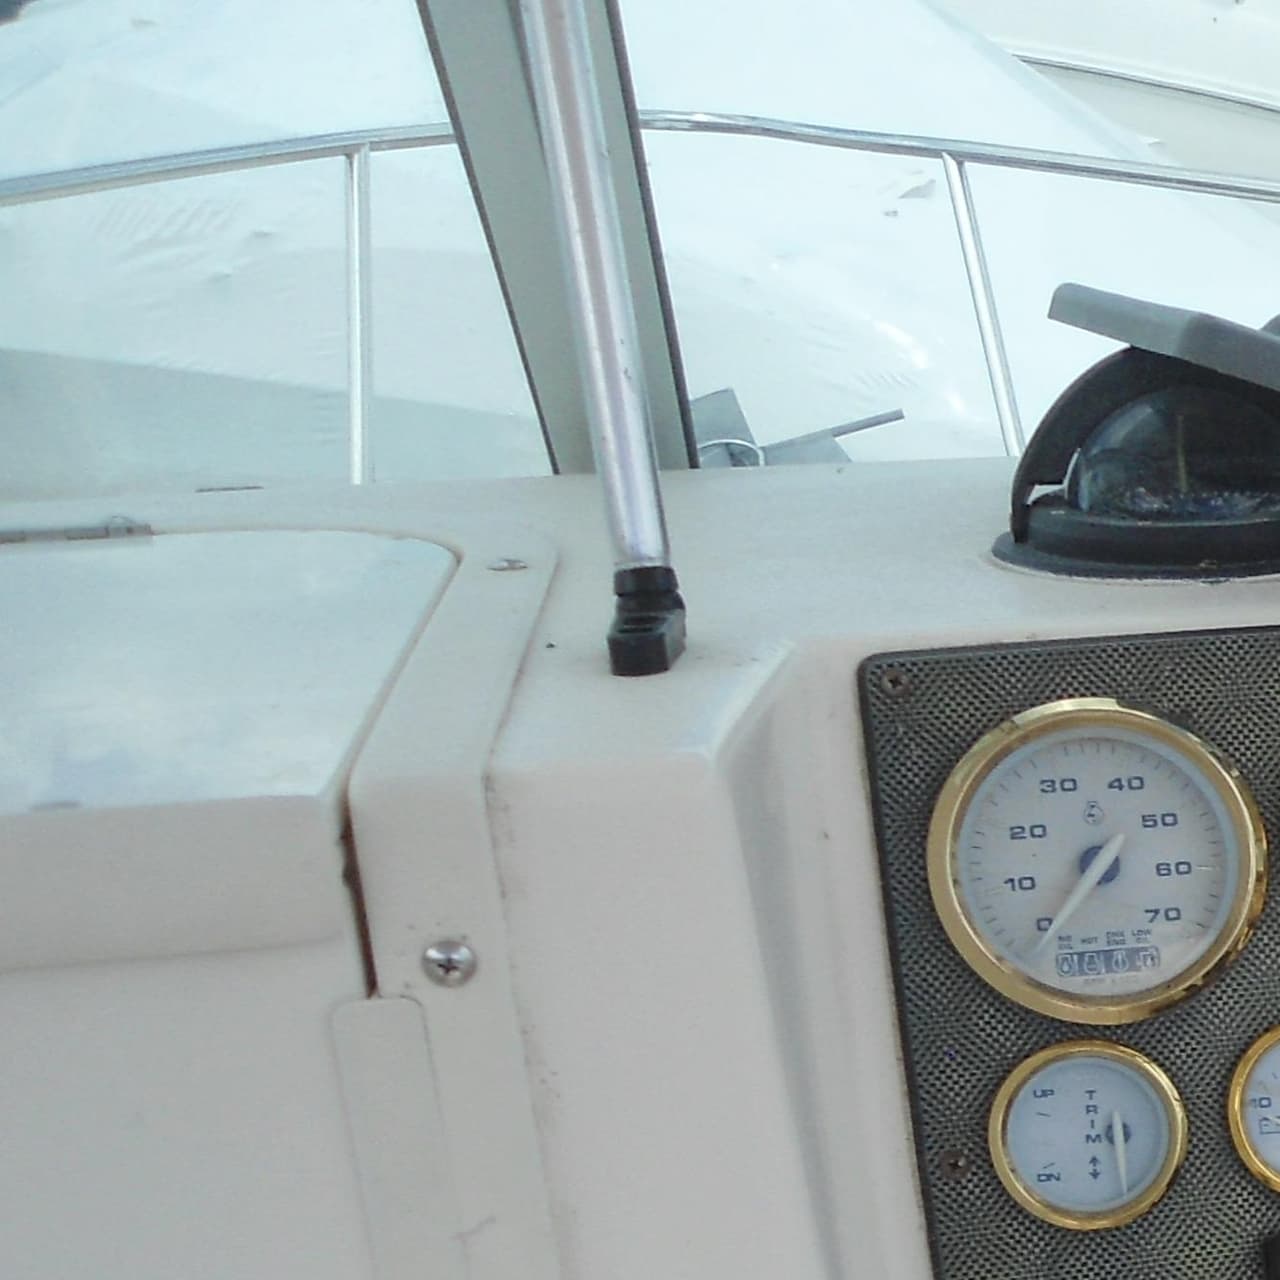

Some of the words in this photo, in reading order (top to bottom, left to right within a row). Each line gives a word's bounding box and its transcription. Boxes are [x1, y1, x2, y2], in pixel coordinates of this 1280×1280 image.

[1039, 778, 1078, 793] 30
[1107, 775, 1146, 792] 40
[1141, 812, 1179, 829] 50
[1009, 824, 1048, 840] 20
[1155, 860, 1193, 877] 60
[1003, 875, 1037, 892] 10
[1143, 907, 1182, 924] 70
[1033, 1089, 1055, 1098] UP
[1250, 1097, 1272, 1109] 10
[1084, 1089, 1102, 1144] TRIM
[1037, 1172, 1061, 1182] DN
